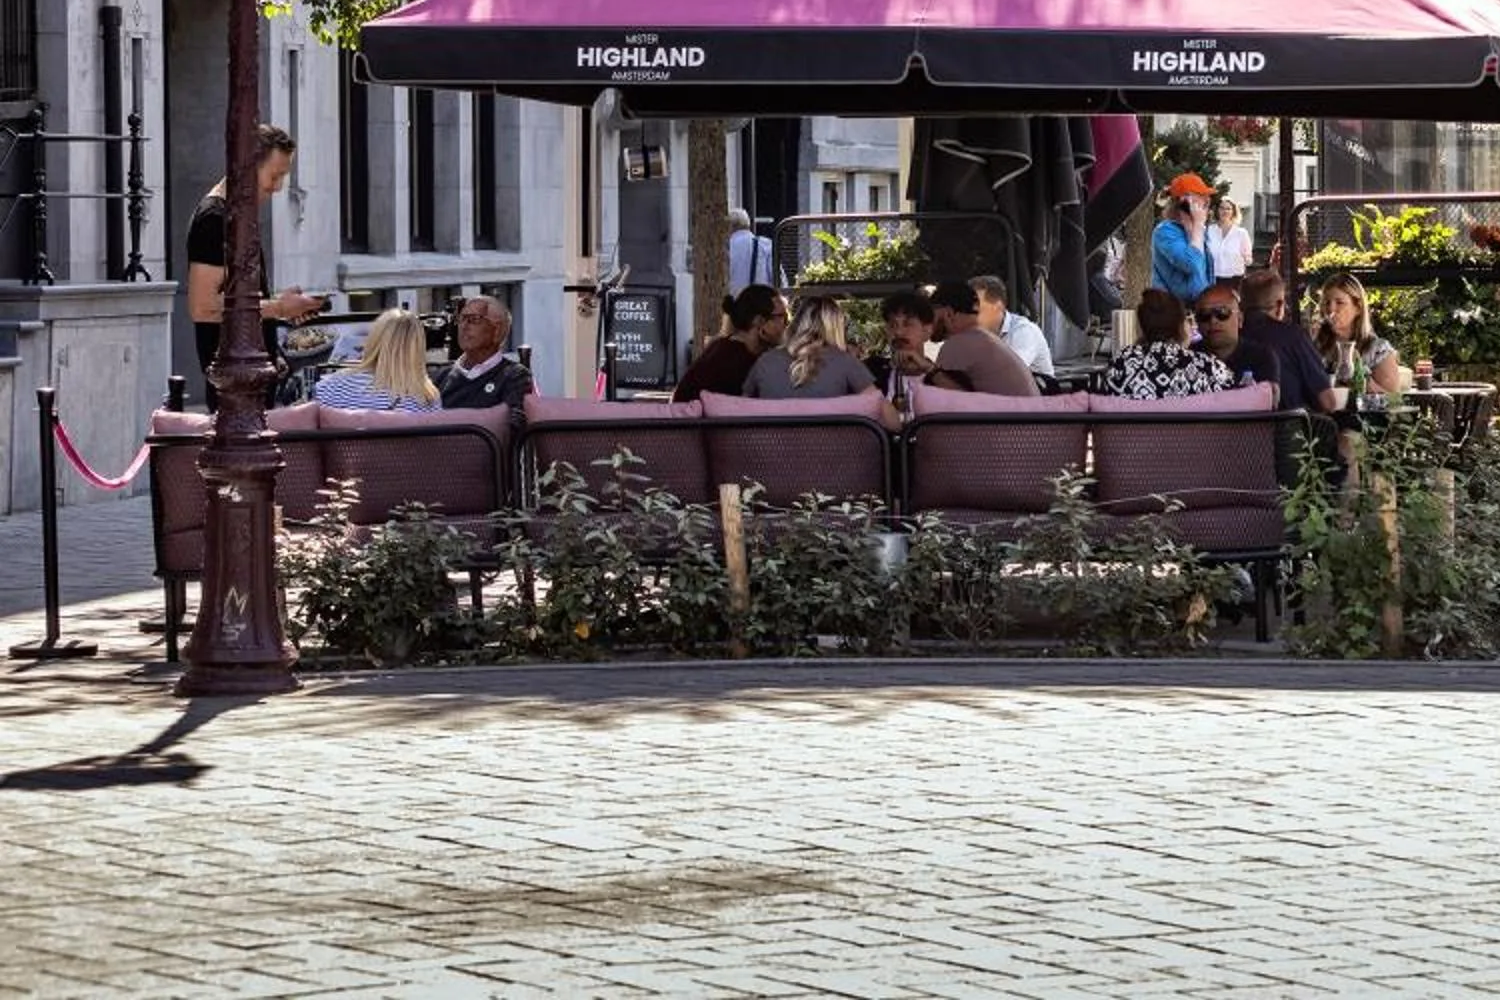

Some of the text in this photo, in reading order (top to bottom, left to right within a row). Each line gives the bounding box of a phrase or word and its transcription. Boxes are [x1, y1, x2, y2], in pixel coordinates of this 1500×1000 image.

[625, 33, 659, 45] MISTER
[1183, 39, 1217, 49] MISTER
[577, 47, 705, 67] HIGHLAND
[1133, 51, 1265, 72] HIGHLAND
[611, 71, 671, 81] AMSTERDAM
[1168, 75, 1229, 85] AMSTERDAM
[615, 301, 649, 311] GREAT
